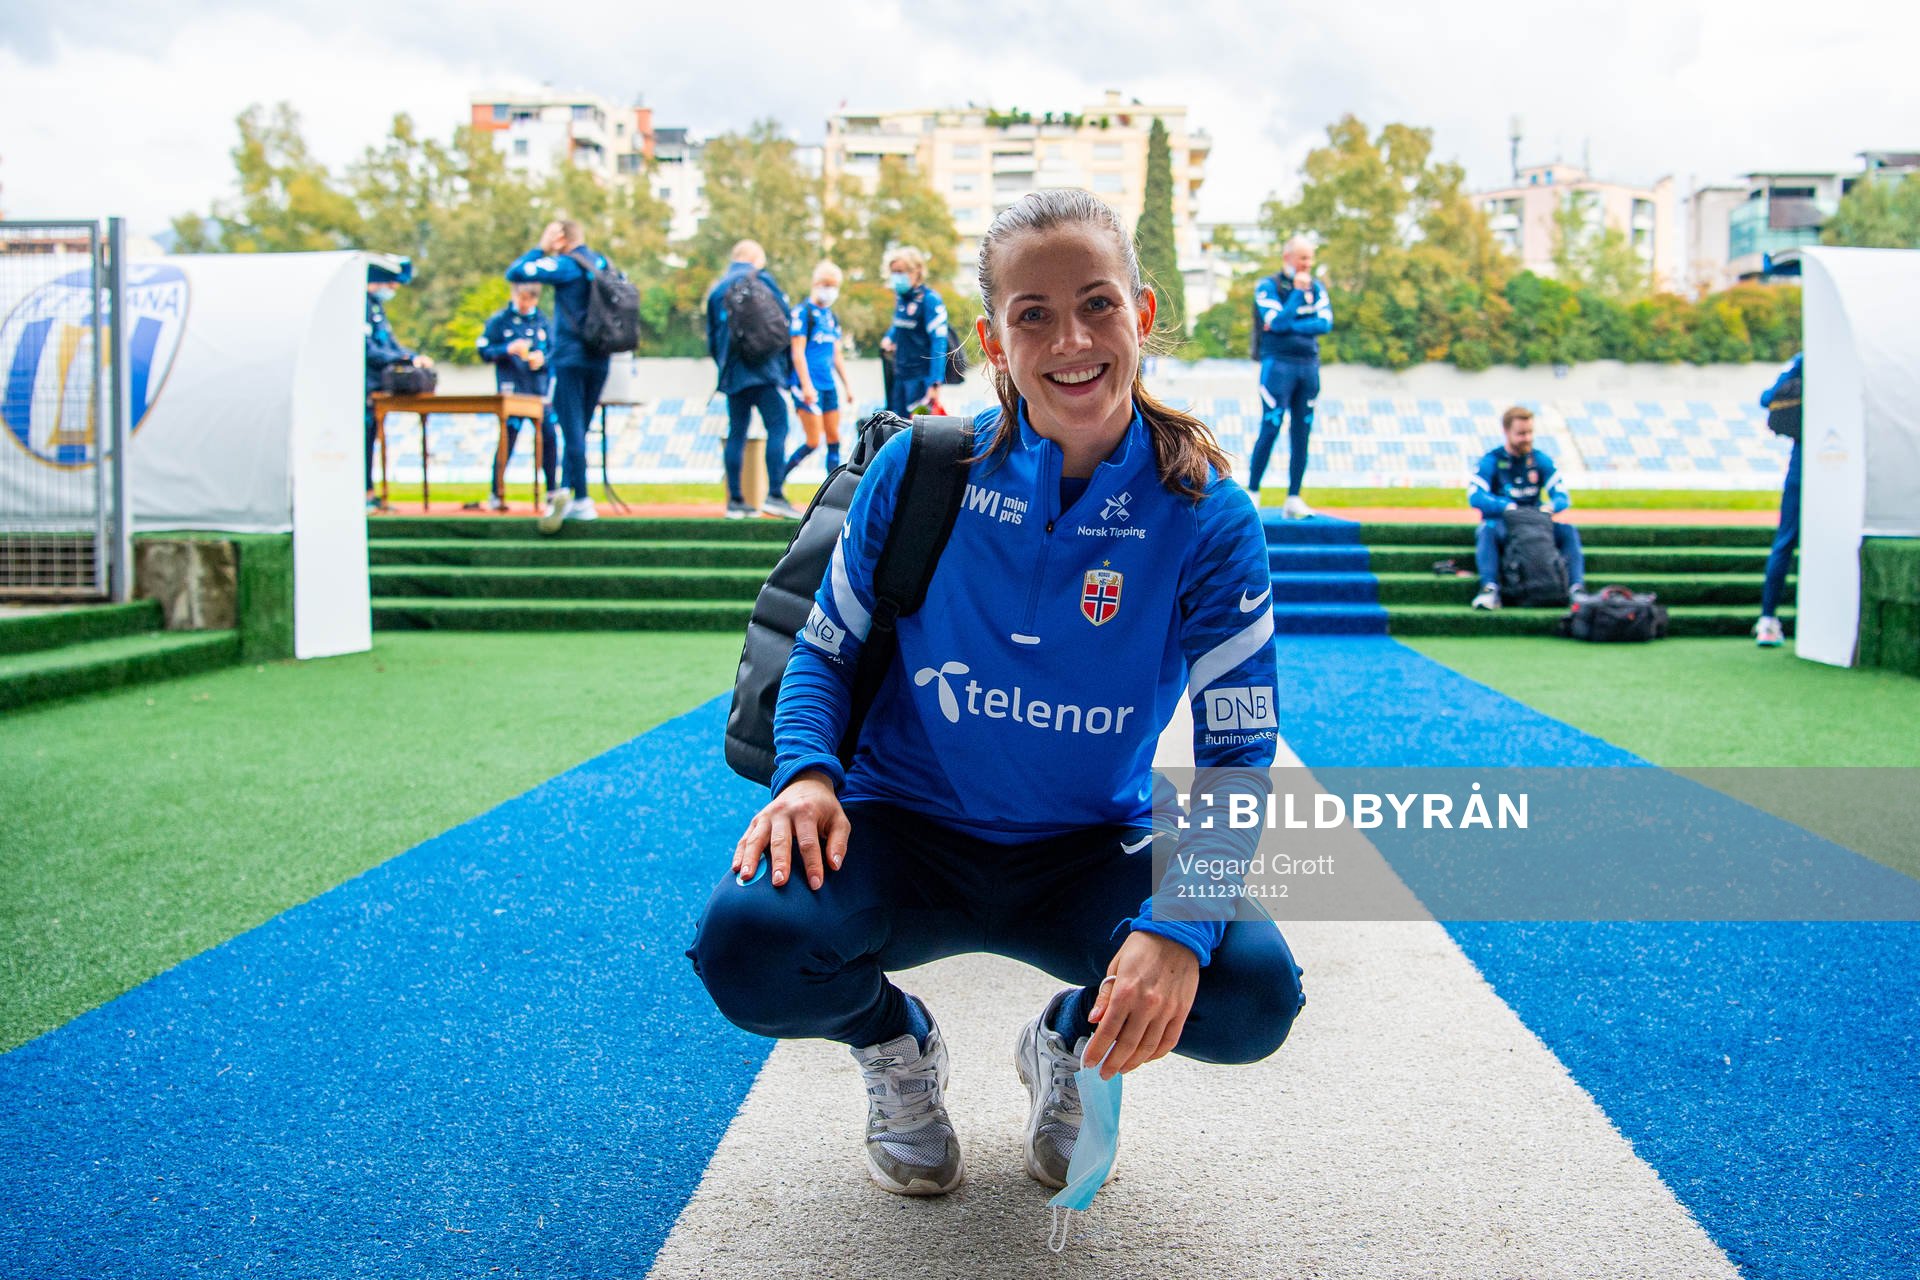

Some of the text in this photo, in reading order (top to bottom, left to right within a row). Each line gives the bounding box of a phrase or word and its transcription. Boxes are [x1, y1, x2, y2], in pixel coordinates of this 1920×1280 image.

[961, 483, 1001, 518] IWI
[1003, 496, 1028, 513] mini
[999, 509, 1023, 525] pris
[1077, 525, 1147, 539] Norsk Tipping
[965, 680, 1134, 734] telenor
[1215, 687, 1267, 729] DNB
